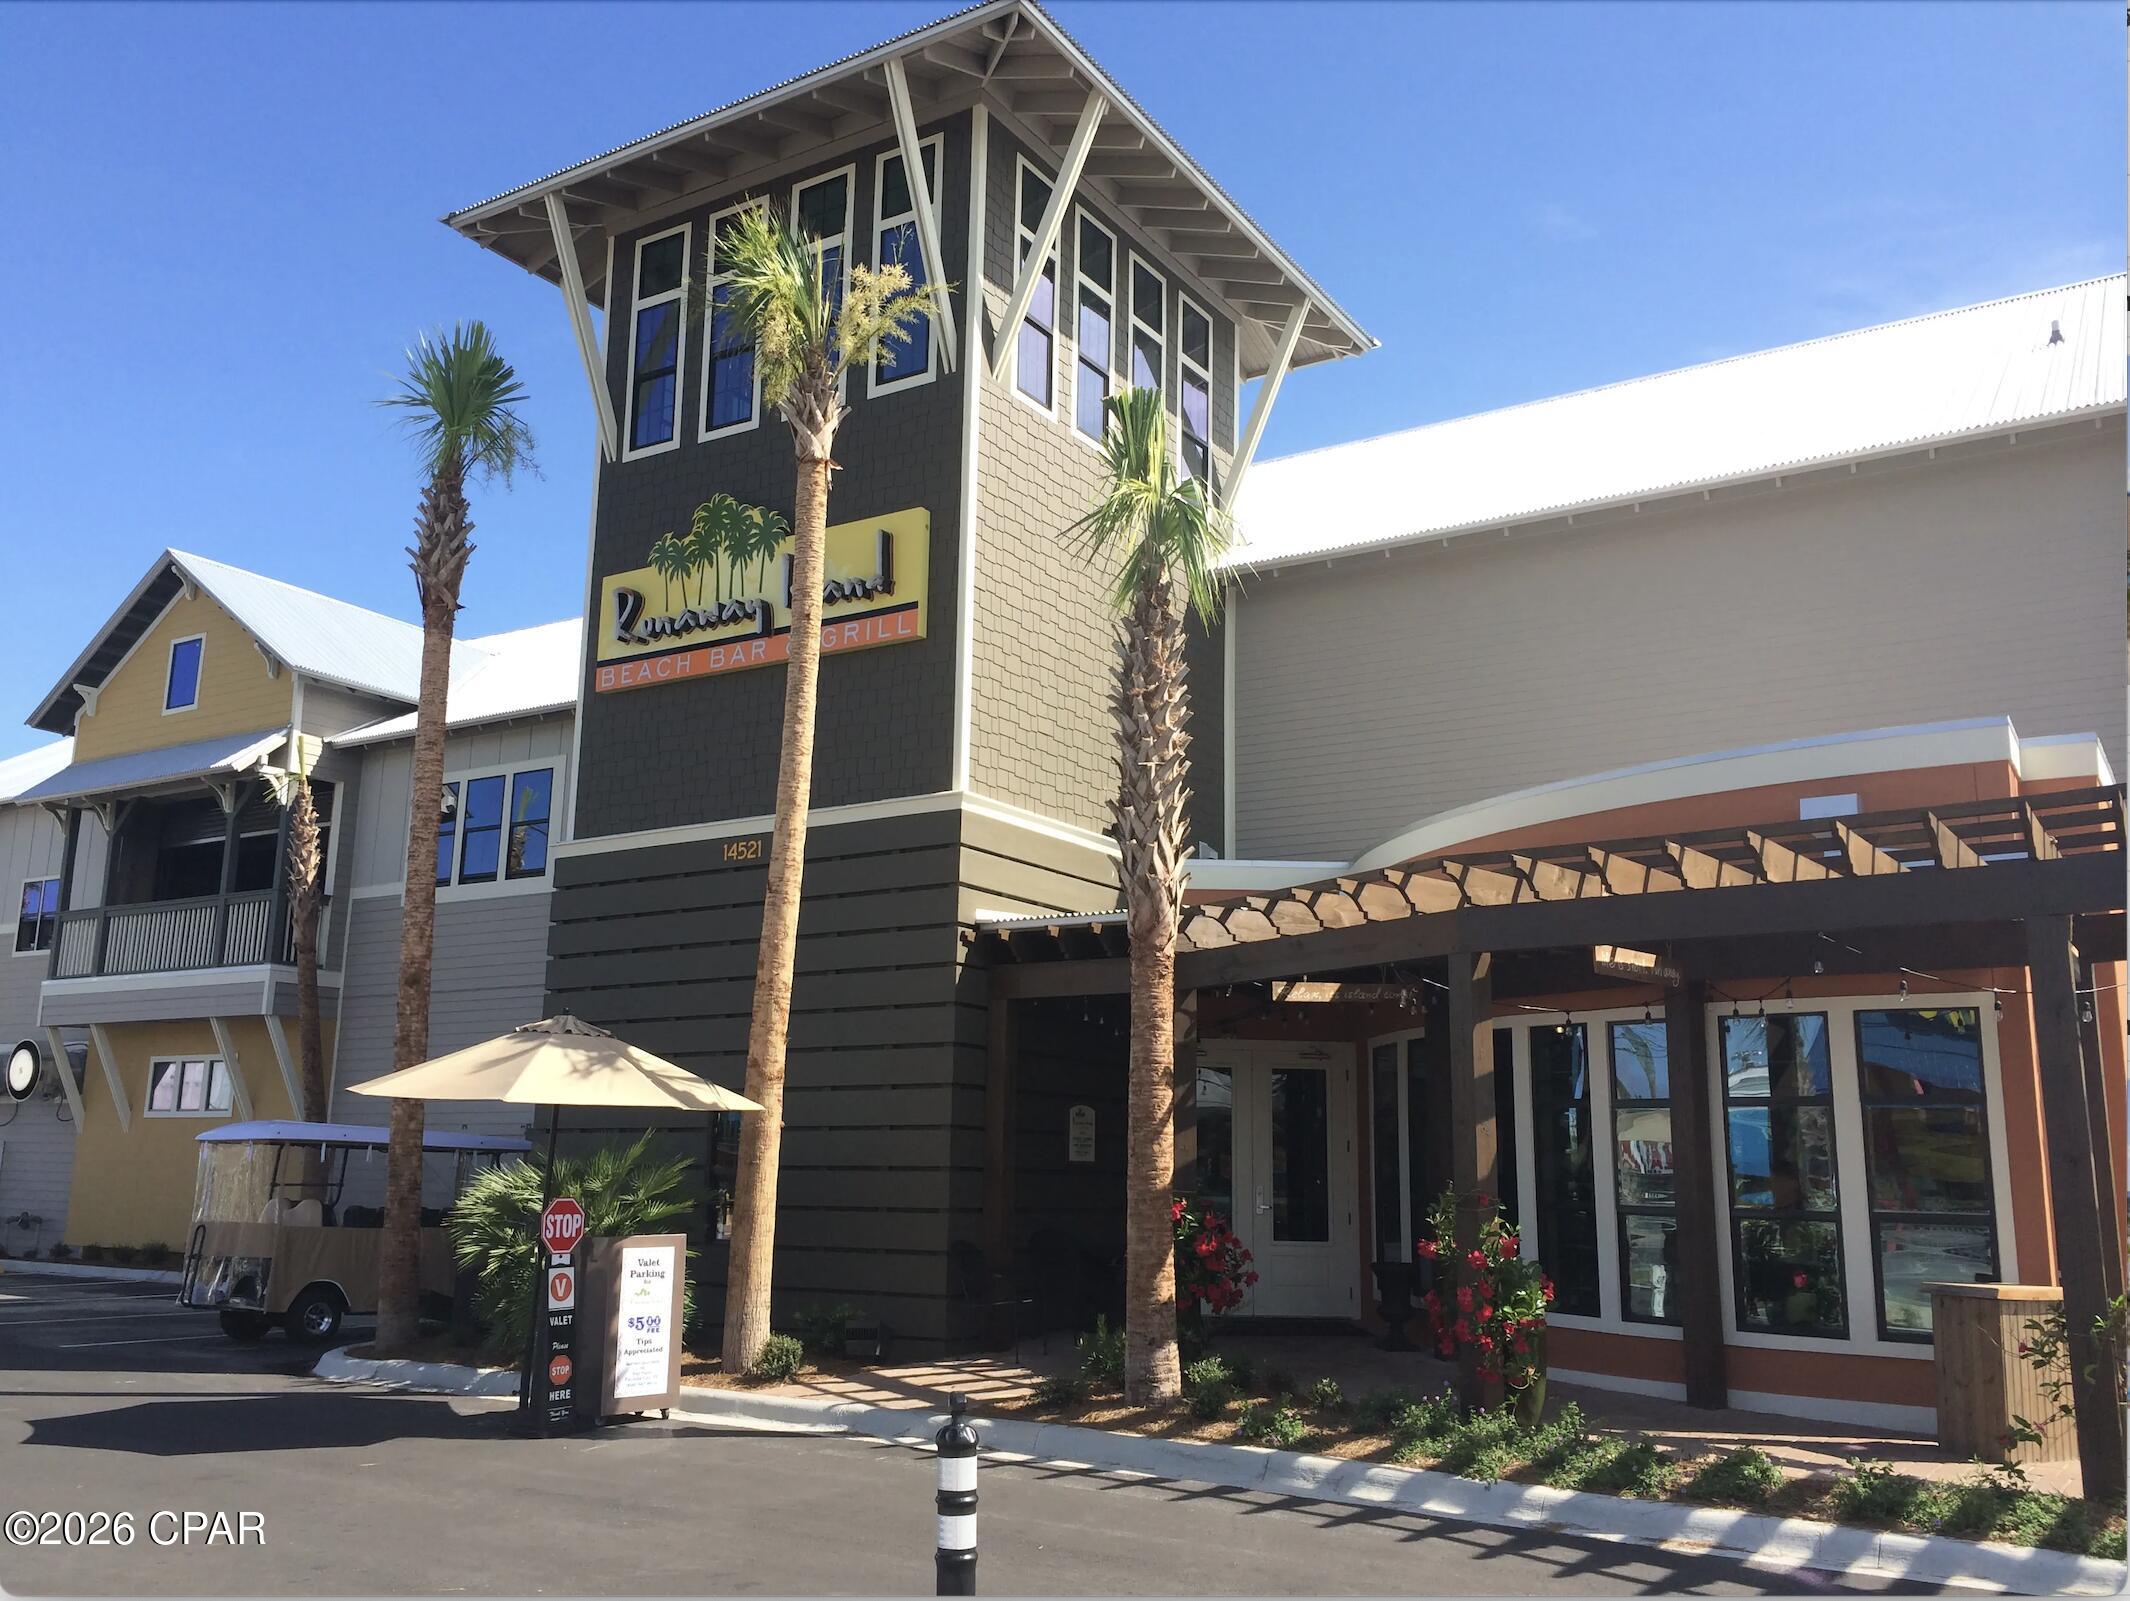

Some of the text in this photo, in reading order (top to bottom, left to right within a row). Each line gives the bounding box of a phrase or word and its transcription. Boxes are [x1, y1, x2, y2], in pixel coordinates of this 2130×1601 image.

[613, 529, 895, 645] Runaway Iand
[601, 655, 691, 688] BEACH
[710, 640, 765, 669] BAR
[821, 614, 912, 648] GRILL
[723, 840, 762, 861] 14521
[545, 1213, 582, 1239] STOP
[637, 1258, 660, 1267] Valet
[630, 1269, 666, 1279] Parking
[554, 1278, 568, 1298] V
[549, 1315, 573, 1326] VALET
[624, 1346, 664, 1356] Appreciated
[551, 1365, 570, 1376] STOP
[549, 1389, 571, 1402] HERE
